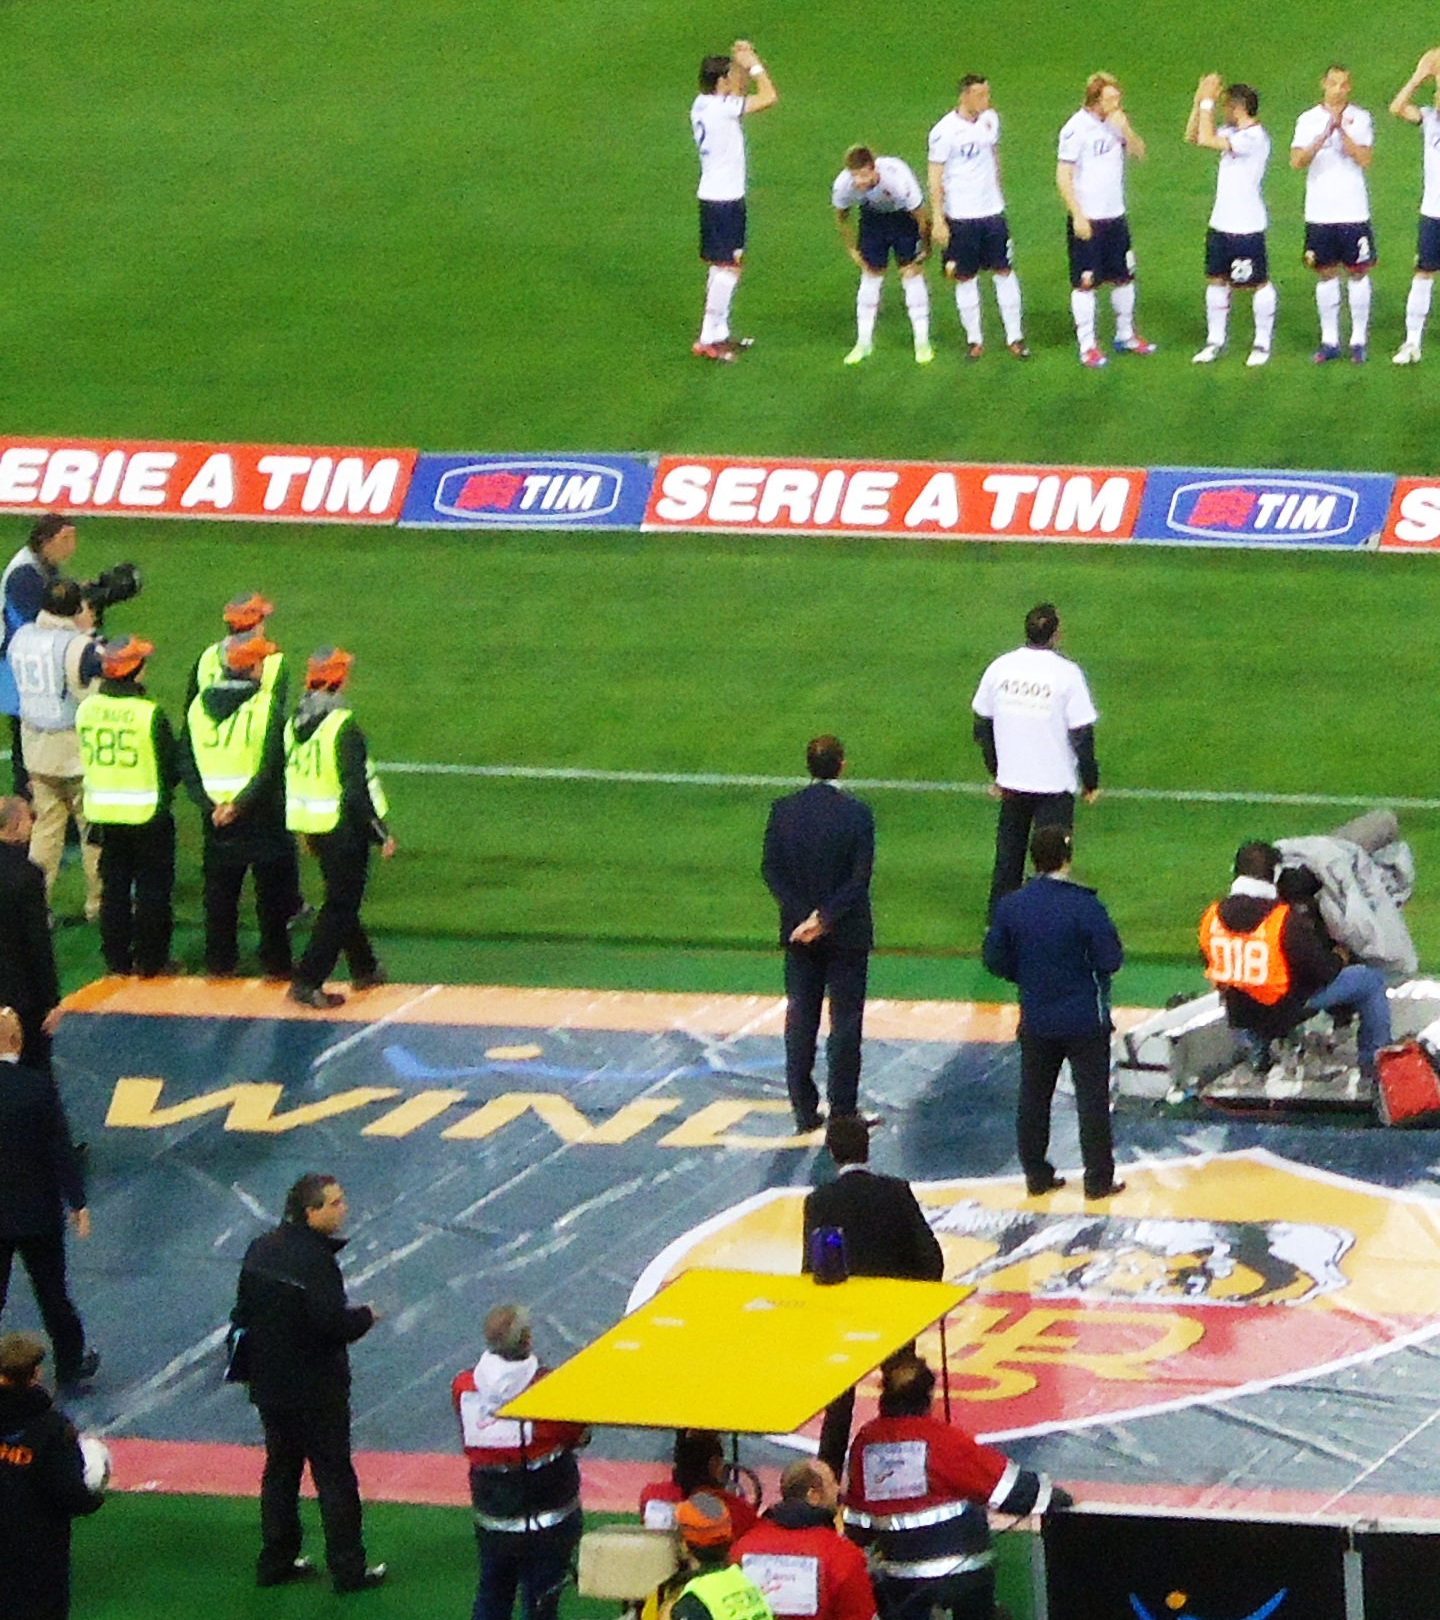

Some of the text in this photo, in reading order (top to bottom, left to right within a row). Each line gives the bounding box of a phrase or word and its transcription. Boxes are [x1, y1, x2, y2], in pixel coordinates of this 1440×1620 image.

[180, 453, 234, 508] A
[257, 455, 400, 515] TIM
[518, 475, 601, 511] TIM
[654, 464, 1130, 532] SERIE A TIM
[1252, 492, 1338, 531] TIM
[80, 724, 138, 768] 585
[1210, 936, 1269, 986] 018
